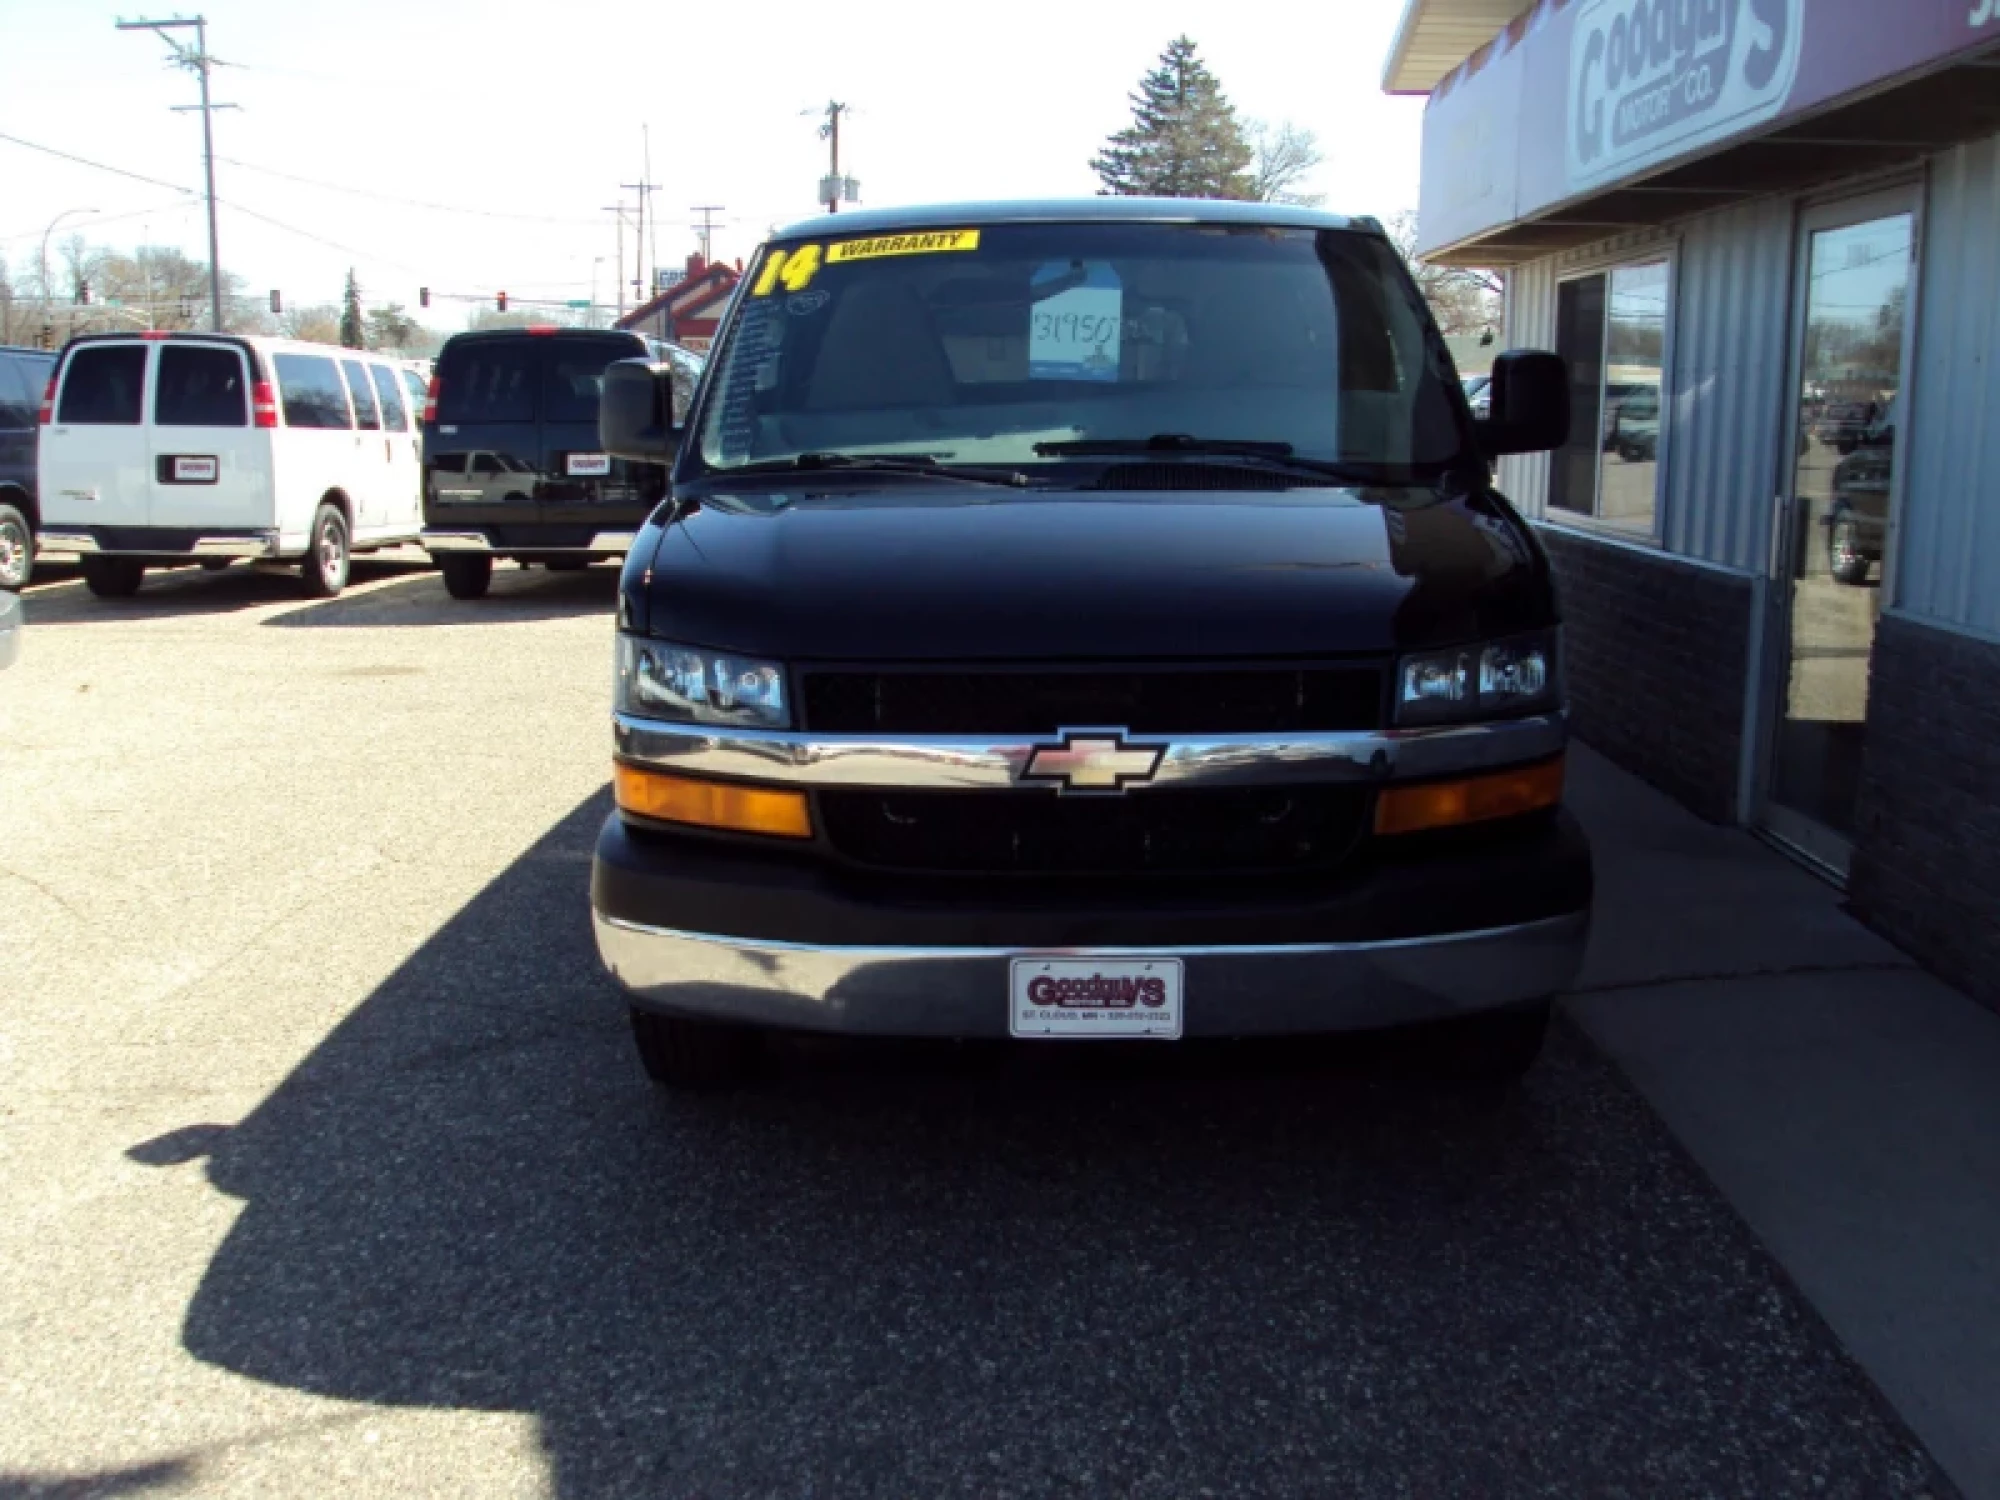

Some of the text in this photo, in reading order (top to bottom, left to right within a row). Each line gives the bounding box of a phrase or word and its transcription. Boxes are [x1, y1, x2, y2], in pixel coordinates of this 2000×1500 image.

[1618, 83, 1671, 137] MOTOR
[752, 244, 822, 296] 14
[840, 231, 964, 258] WARRANTY
